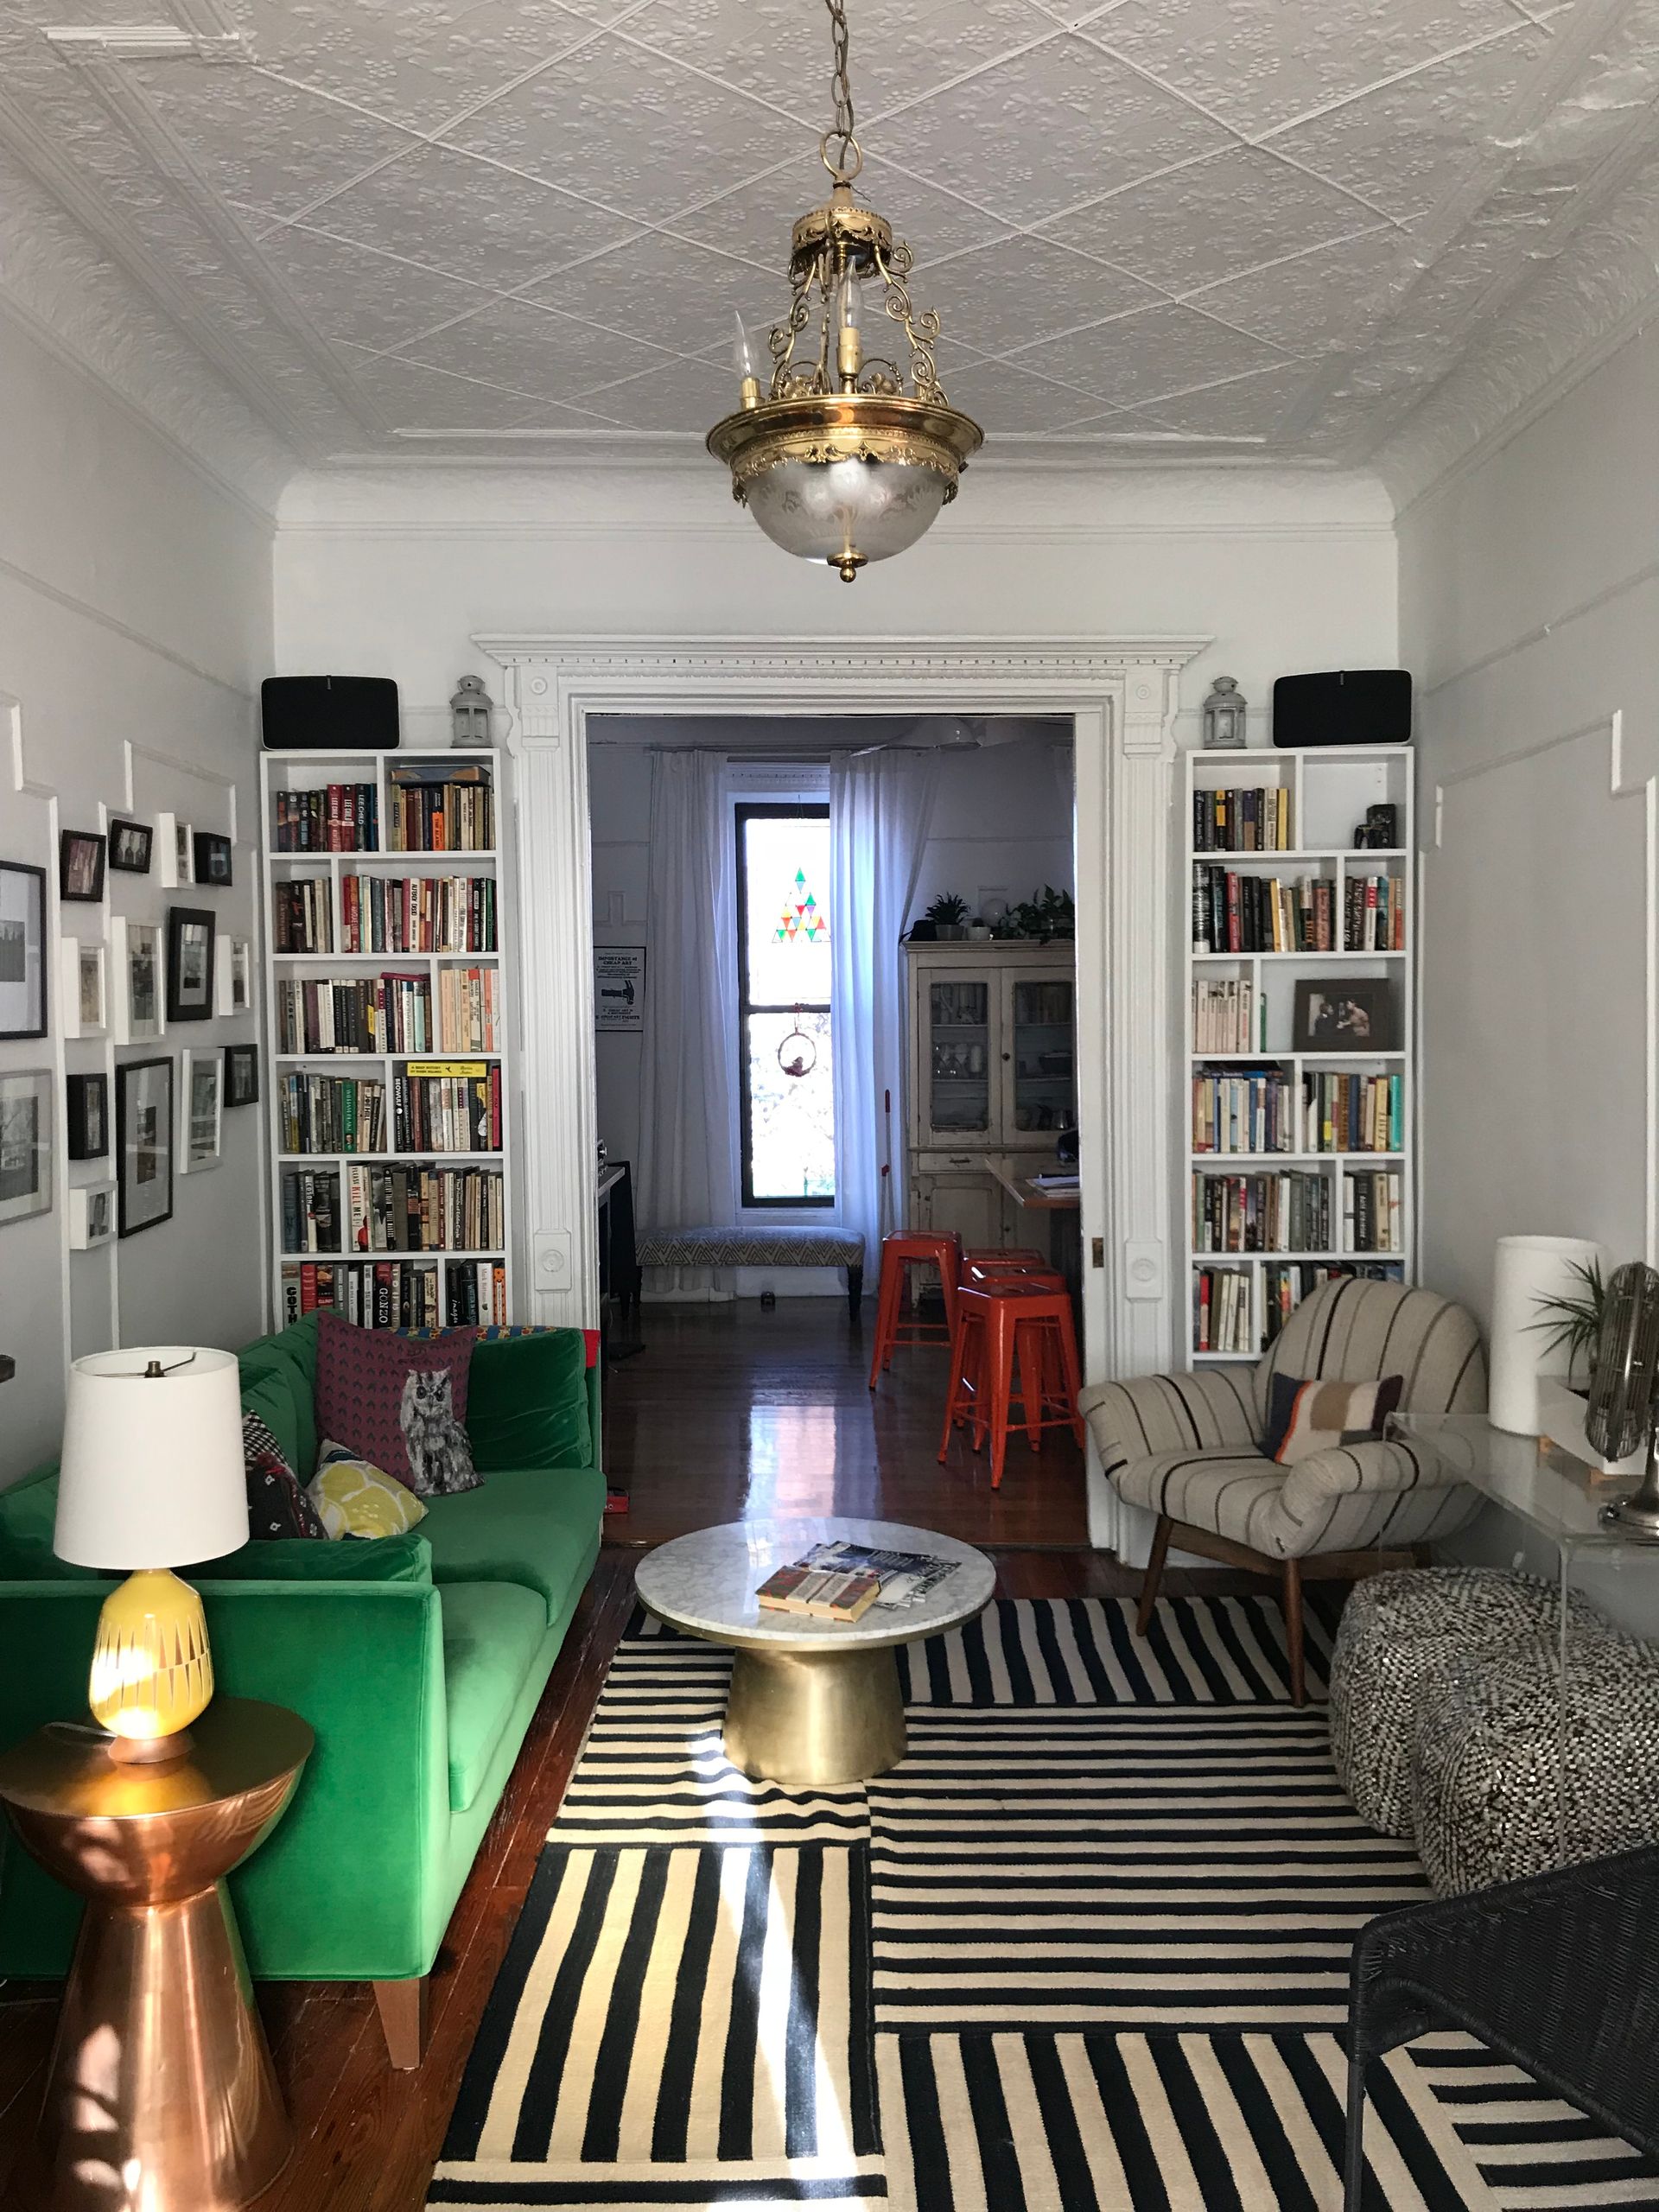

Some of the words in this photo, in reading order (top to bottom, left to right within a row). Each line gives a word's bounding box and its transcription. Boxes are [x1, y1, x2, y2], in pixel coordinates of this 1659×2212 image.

[352, 1186, 360, 1204] KILL
[353, 1206, 361, 1217] ME
[286, 1286, 297, 1325] GOTH
[379, 1287, 389, 1324] GONZO
